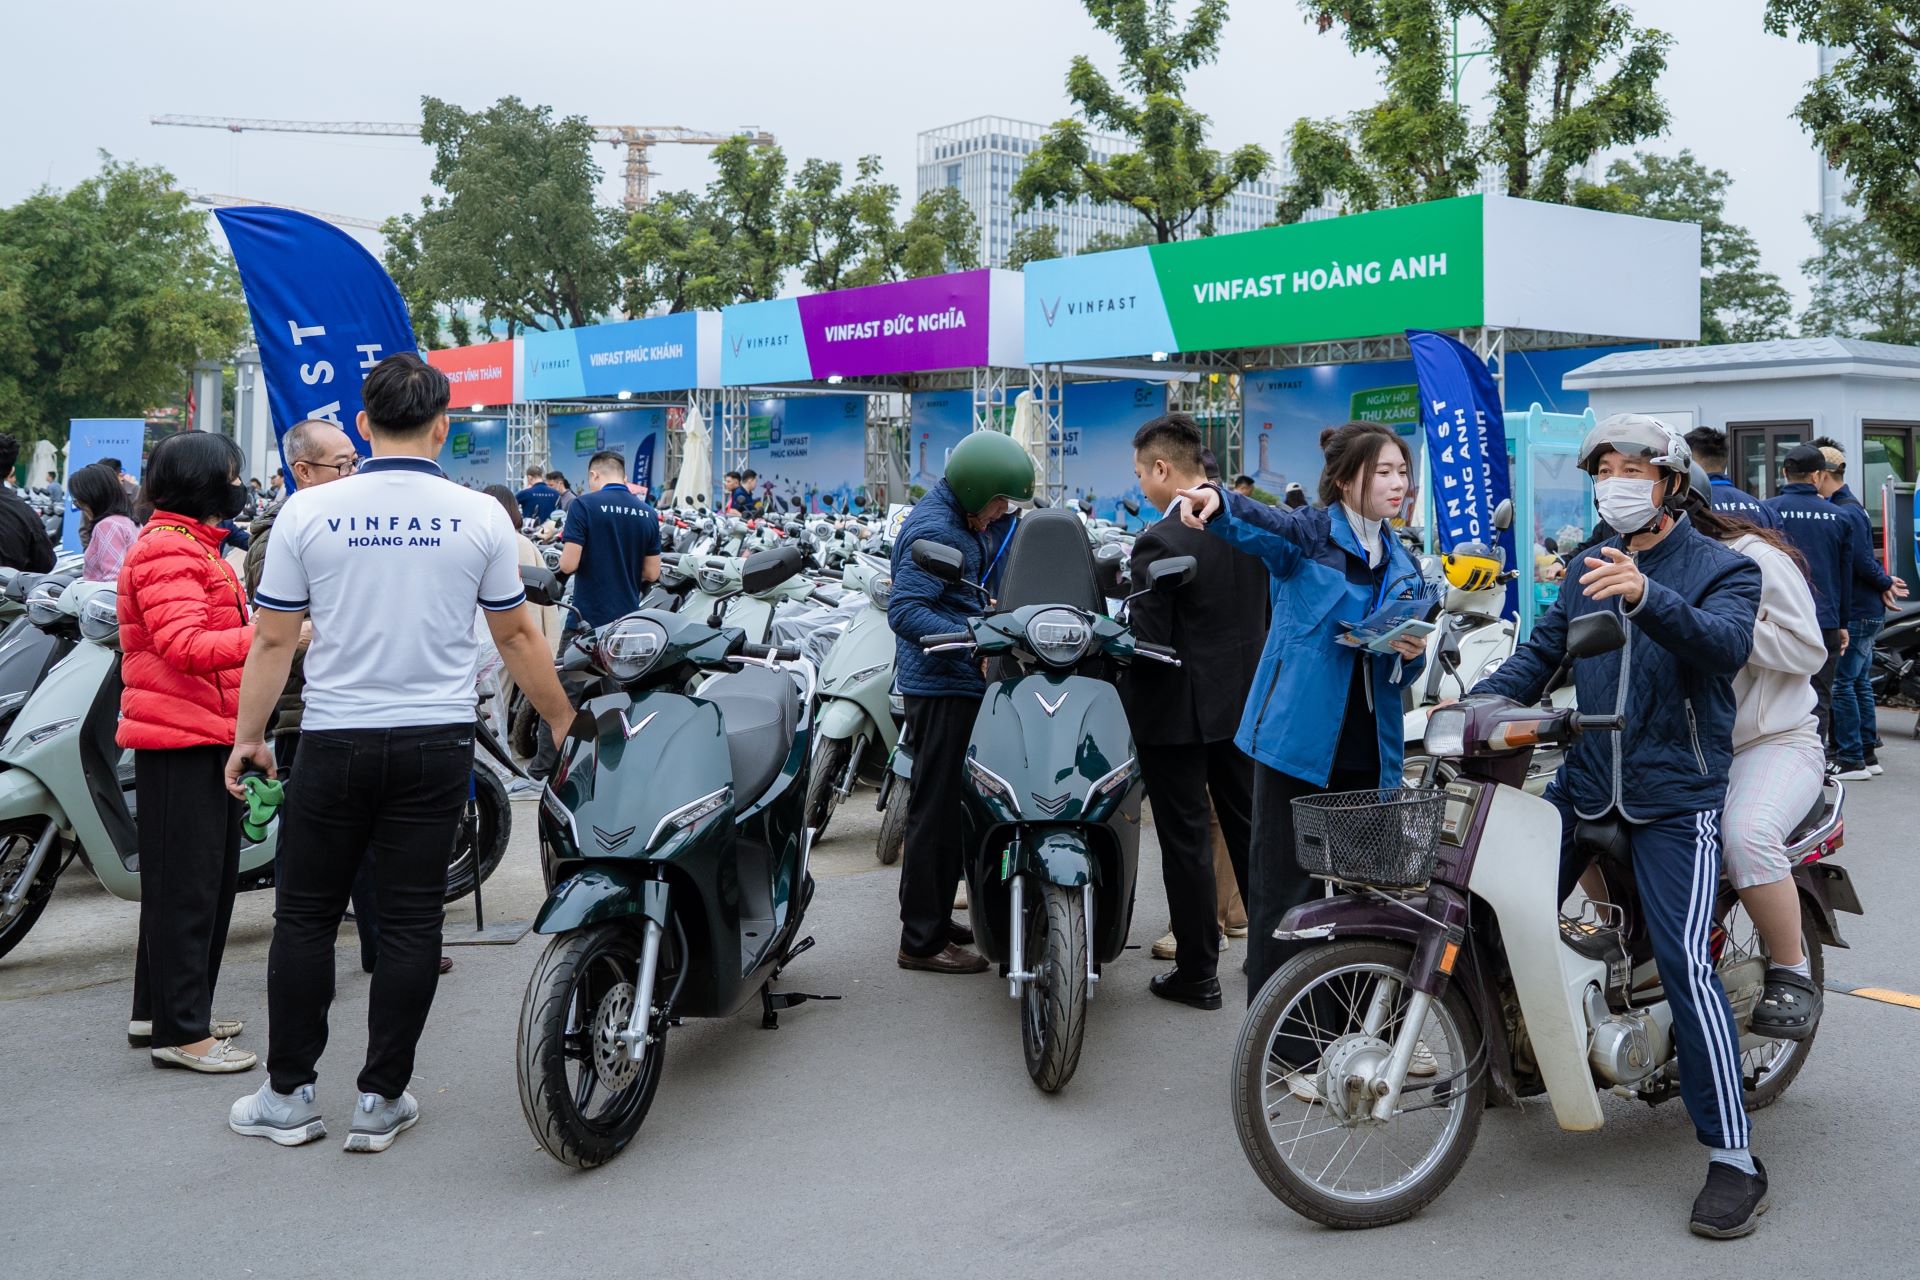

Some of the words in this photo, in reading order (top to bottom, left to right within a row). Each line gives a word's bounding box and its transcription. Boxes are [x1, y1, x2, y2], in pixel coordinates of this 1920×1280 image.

[1193, 273, 1286, 304] VINFAST
[1292, 261, 1381, 294] HOÀNG
[1389, 252, 1448, 282] ANH
[1068, 296, 1136, 315] VINFAST
[825, 321, 881, 343] VINFAST
[883, 313, 914, 336] ĐỨC
[918, 306, 967, 332] NGHĨA
[747, 334, 789, 349] VINFAST
[590, 350, 624, 367] VINFAST
[625, 344, 649, 364] PHÚC
[650, 341, 683, 361] KHÁNH
[541, 359, 571, 370] VINFAST
[446, 371, 463, 383] FAST
[479, 364, 502, 381] THÀNH
[1268, 381, 1303, 391] VINFAST
[1366, 393, 1391, 406] NGÀY
[1360, 411, 1383, 422] THU
[1384, 406, 1416, 420] XĂNG
[783, 436, 808, 447] VINFAST
[1050, 431, 1079, 442] NAST
[1454, 408, 1471, 460] ANH
[1050, 443, 1079, 456] NHĨA
[1433, 399, 1464, 538] INFAST
[600, 504, 650, 519] VINFAST
[1714, 501, 1761, 513] INFAST
[1780, 510, 1837, 521] VINFAST
[327, 516, 462, 533] VINFAST
[348, 534, 403, 548] HOÀNG
[408, 536, 441, 547] ANH
